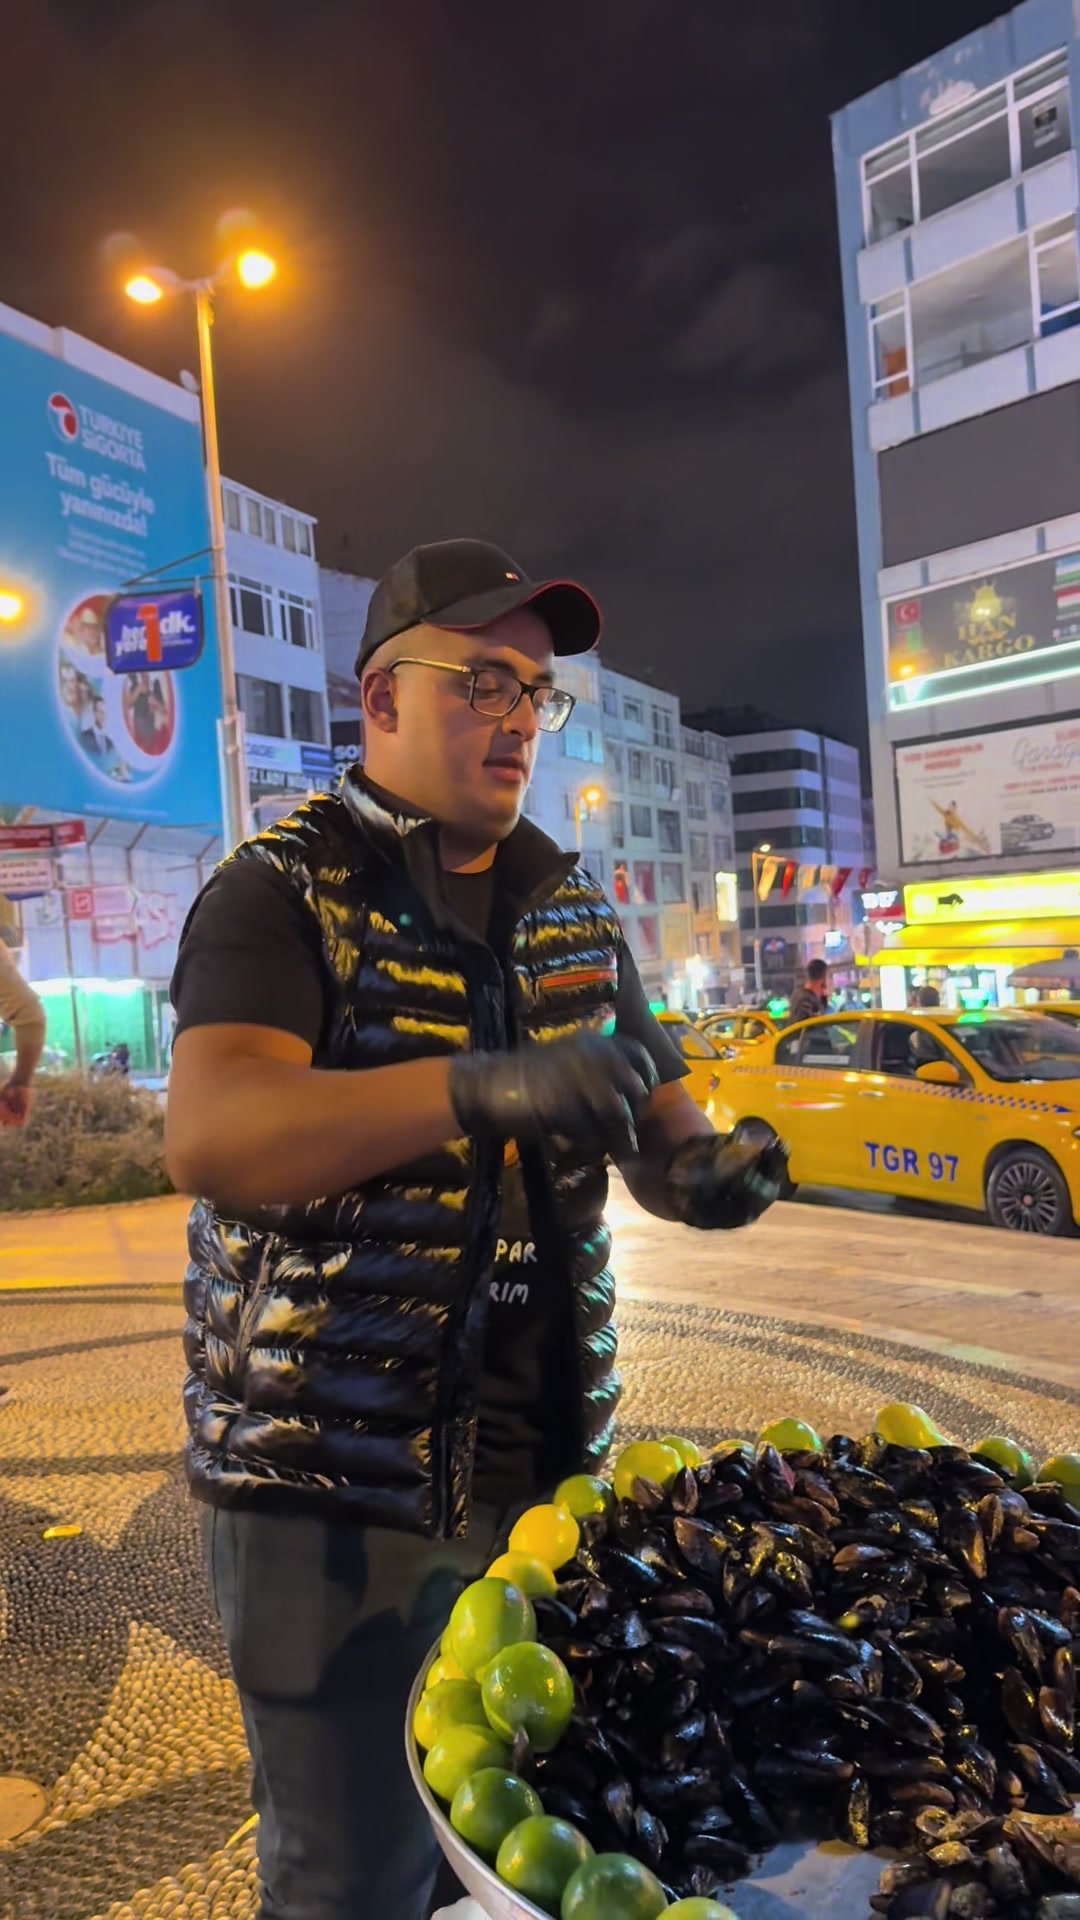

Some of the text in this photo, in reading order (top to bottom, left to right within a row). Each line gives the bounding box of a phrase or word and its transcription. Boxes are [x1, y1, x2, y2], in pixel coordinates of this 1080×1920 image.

[136, 602, 163, 662] 1
[943, 634, 1036, 668] KARGO
[334, 744, 363, 761] SO
[1012, 736, 1080, 774] Garag
[864, 1141, 959, 1183] TGR 97
[494, 1238, 538, 1264] PAR
